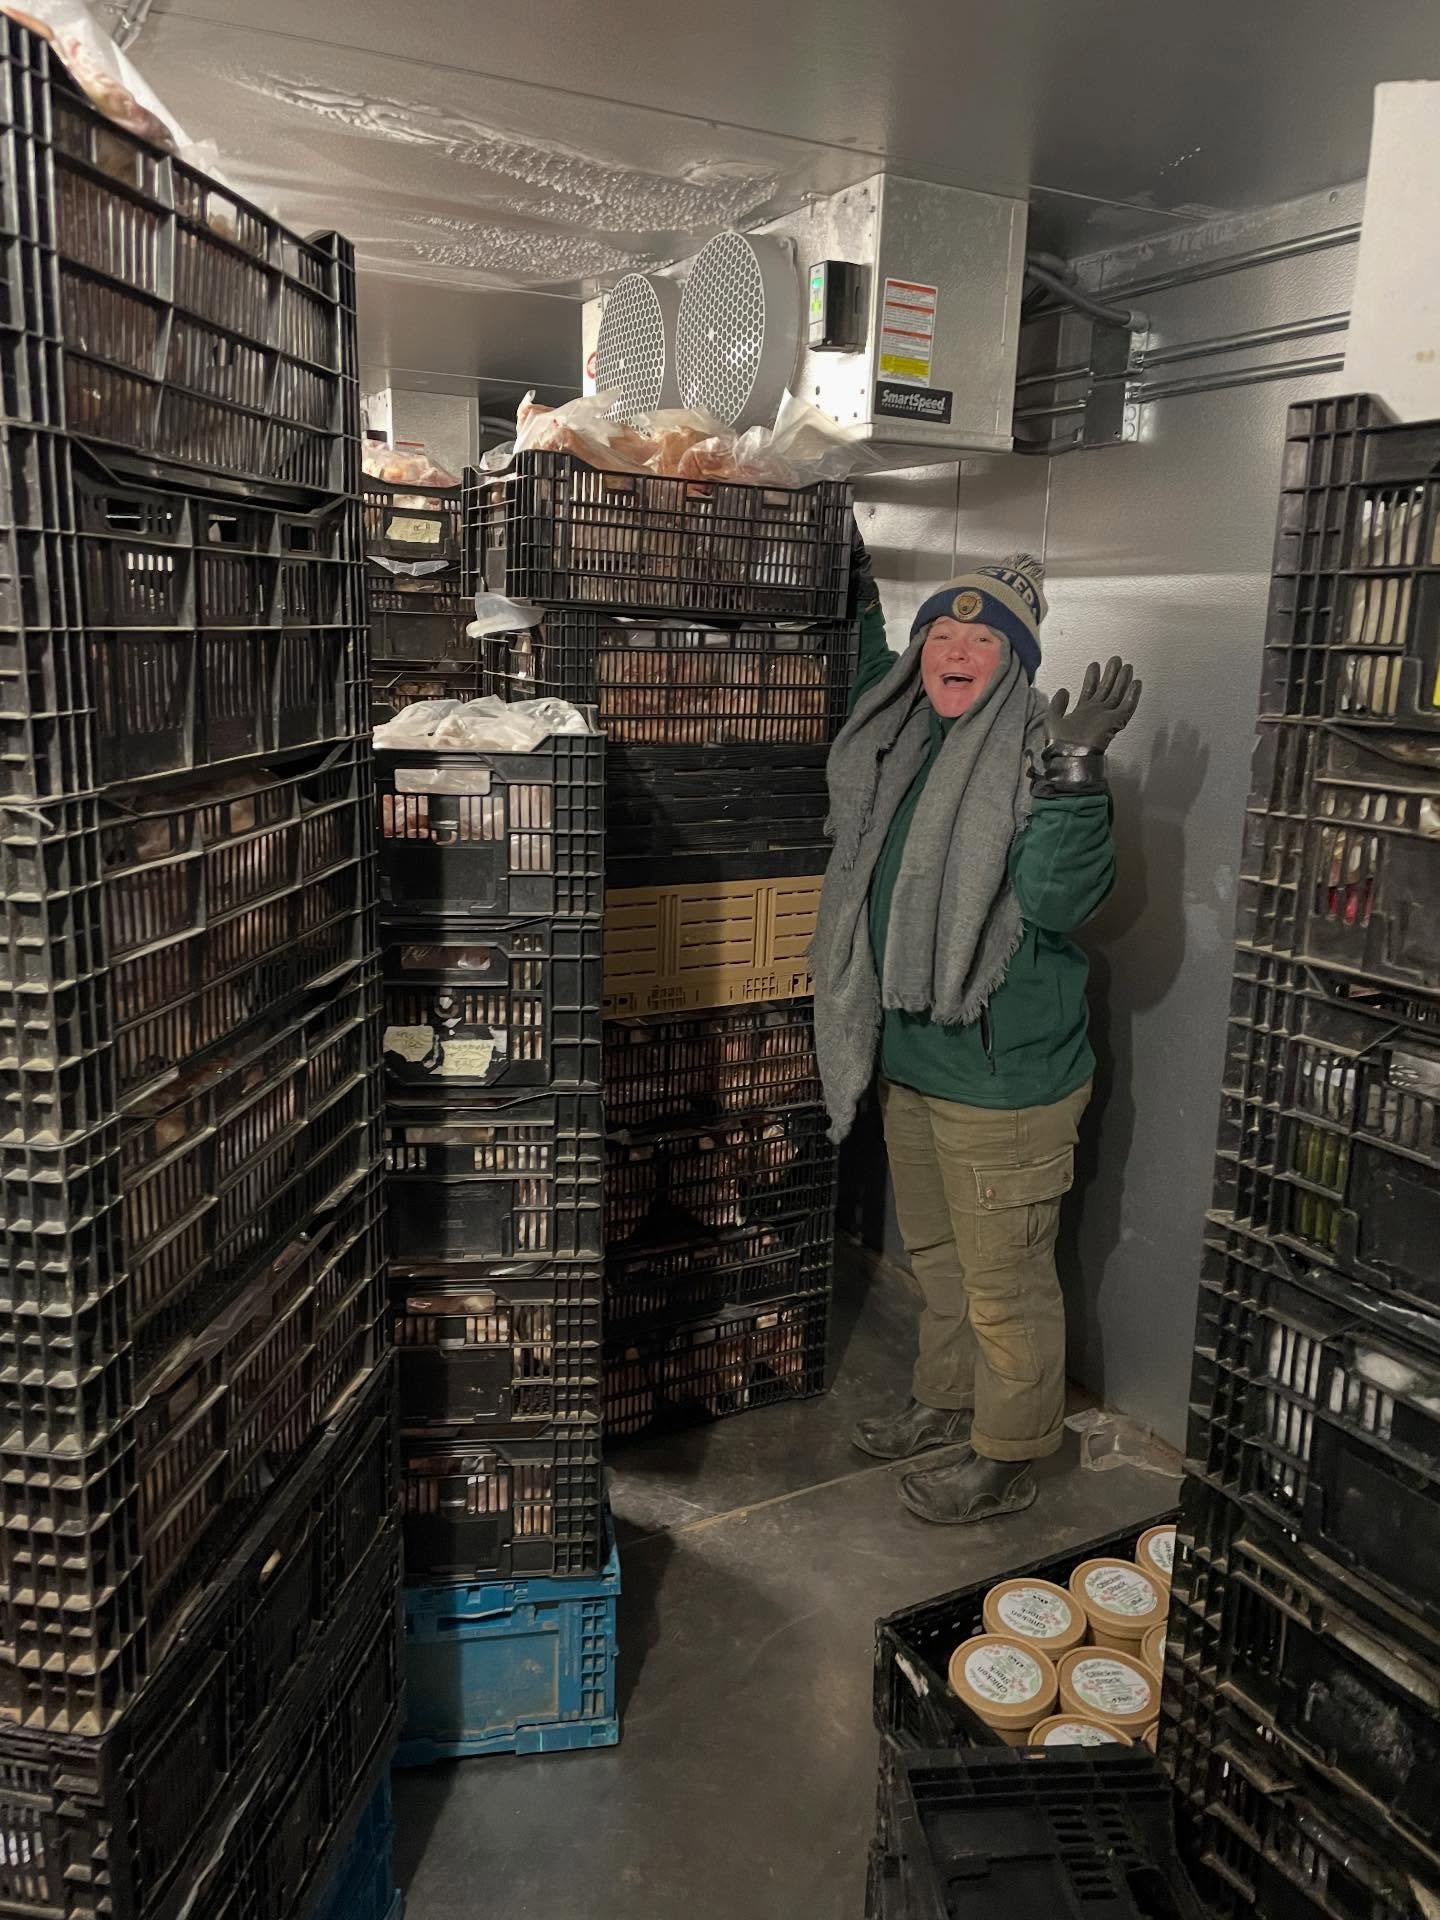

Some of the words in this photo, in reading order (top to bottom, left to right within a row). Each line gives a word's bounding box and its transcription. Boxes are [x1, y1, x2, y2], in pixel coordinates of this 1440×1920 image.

[881, 389, 945, 411] SmartSpeed
[1010, 1608, 1047, 1631] Chicken
[976, 1665, 1009, 1695] Chicken
